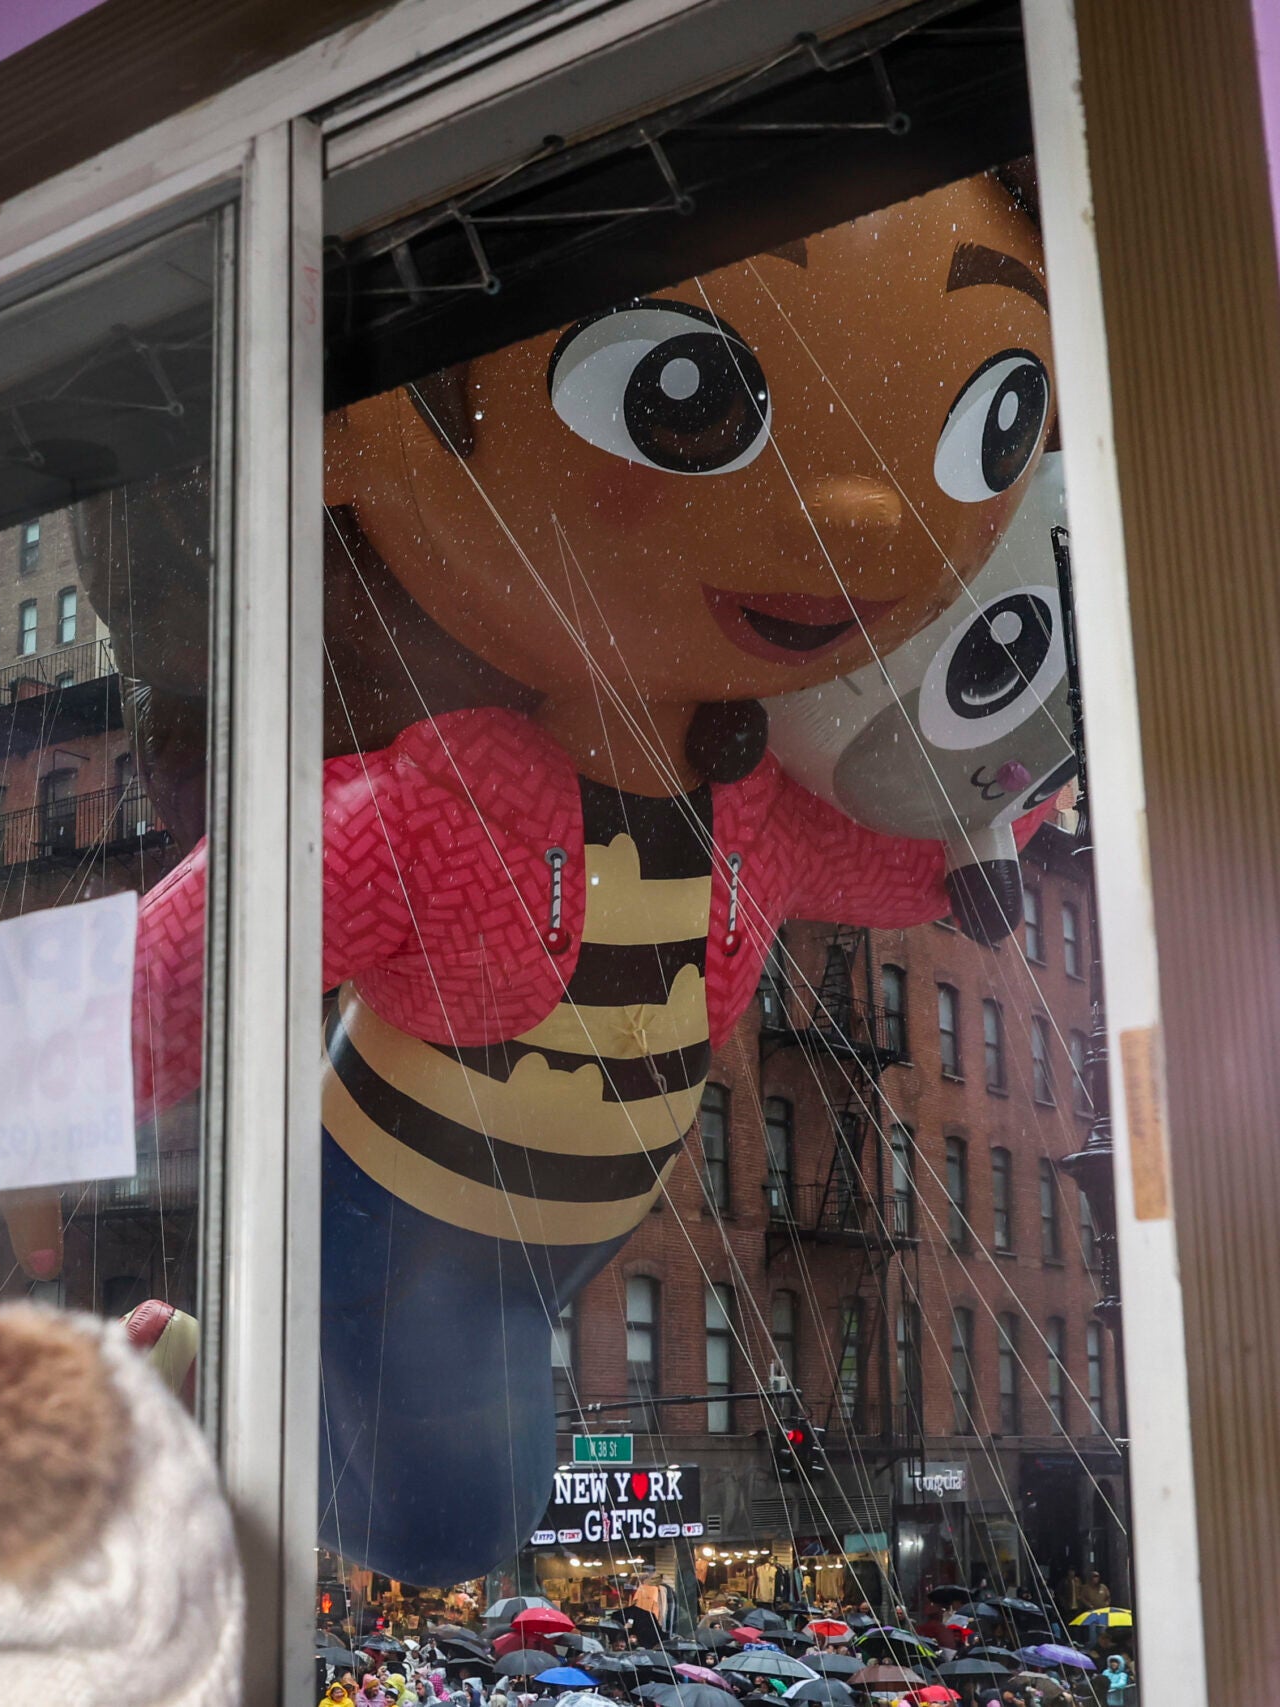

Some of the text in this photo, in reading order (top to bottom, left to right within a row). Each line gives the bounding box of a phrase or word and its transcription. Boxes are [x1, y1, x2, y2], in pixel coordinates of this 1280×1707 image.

[598, 1440, 607, 1458] 38
[609, 1441, 618, 1457] St
[553, 1472, 608, 1504] NEW
